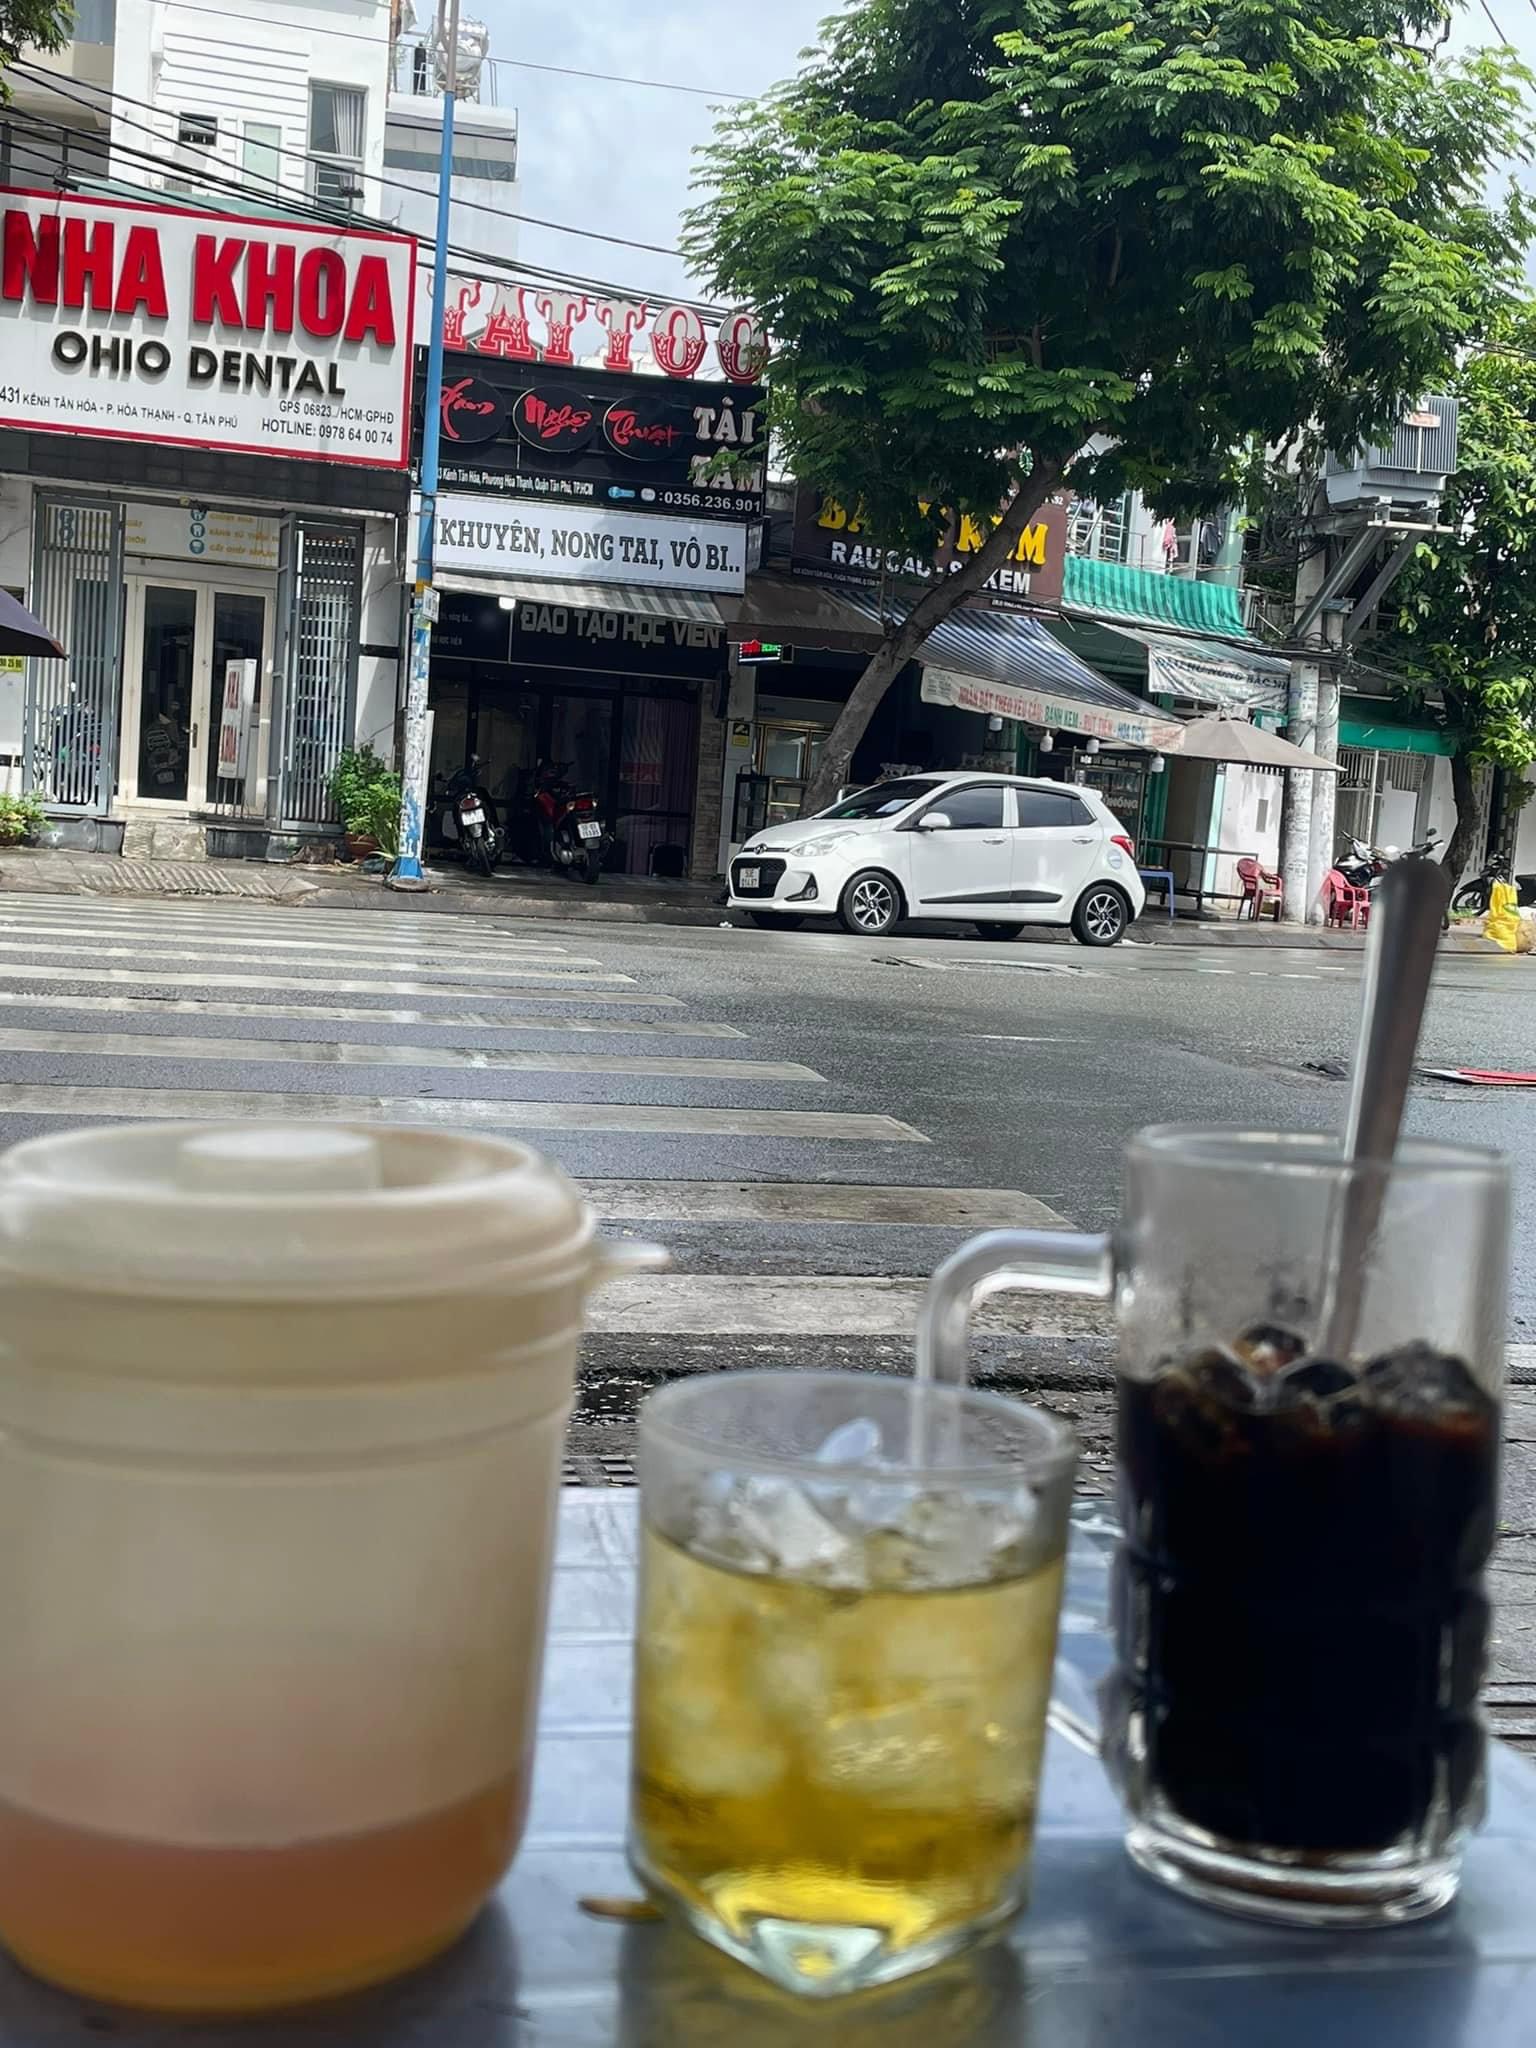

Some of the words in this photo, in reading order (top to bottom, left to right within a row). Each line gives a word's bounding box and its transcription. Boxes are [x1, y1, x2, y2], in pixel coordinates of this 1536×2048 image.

[3, 209, 169, 320] NHA
[193, 233, 396, 348] KHOA
[428, 274, 771, 385] TATTOO
[53, 330, 171, 376] OHIO
[190, 345, 346, 397] DENTAL
[0, 385, 20, 405] 431
[141, 407, 175, 423] THẠNH
[280, 400, 300, 414] GPS
[262, 418, 317, 437] HOTLINE:
[319, 424, 345, 440] 0978
[348, 427, 361, 441] 64
[365, 430, 378, 443] 00
[381, 431, 393, 445] 74
[440, 519, 545, 559] KHUYÊN,
[551, 529, 614, 561] NONG
[619, 535, 664, 570] TAI,
[670, 536, 700, 569] VÔ
[831, 541, 882, 571] RAU
[573, 608, 618, 645] TẠO
[622, 613, 668, 649] HỌC
